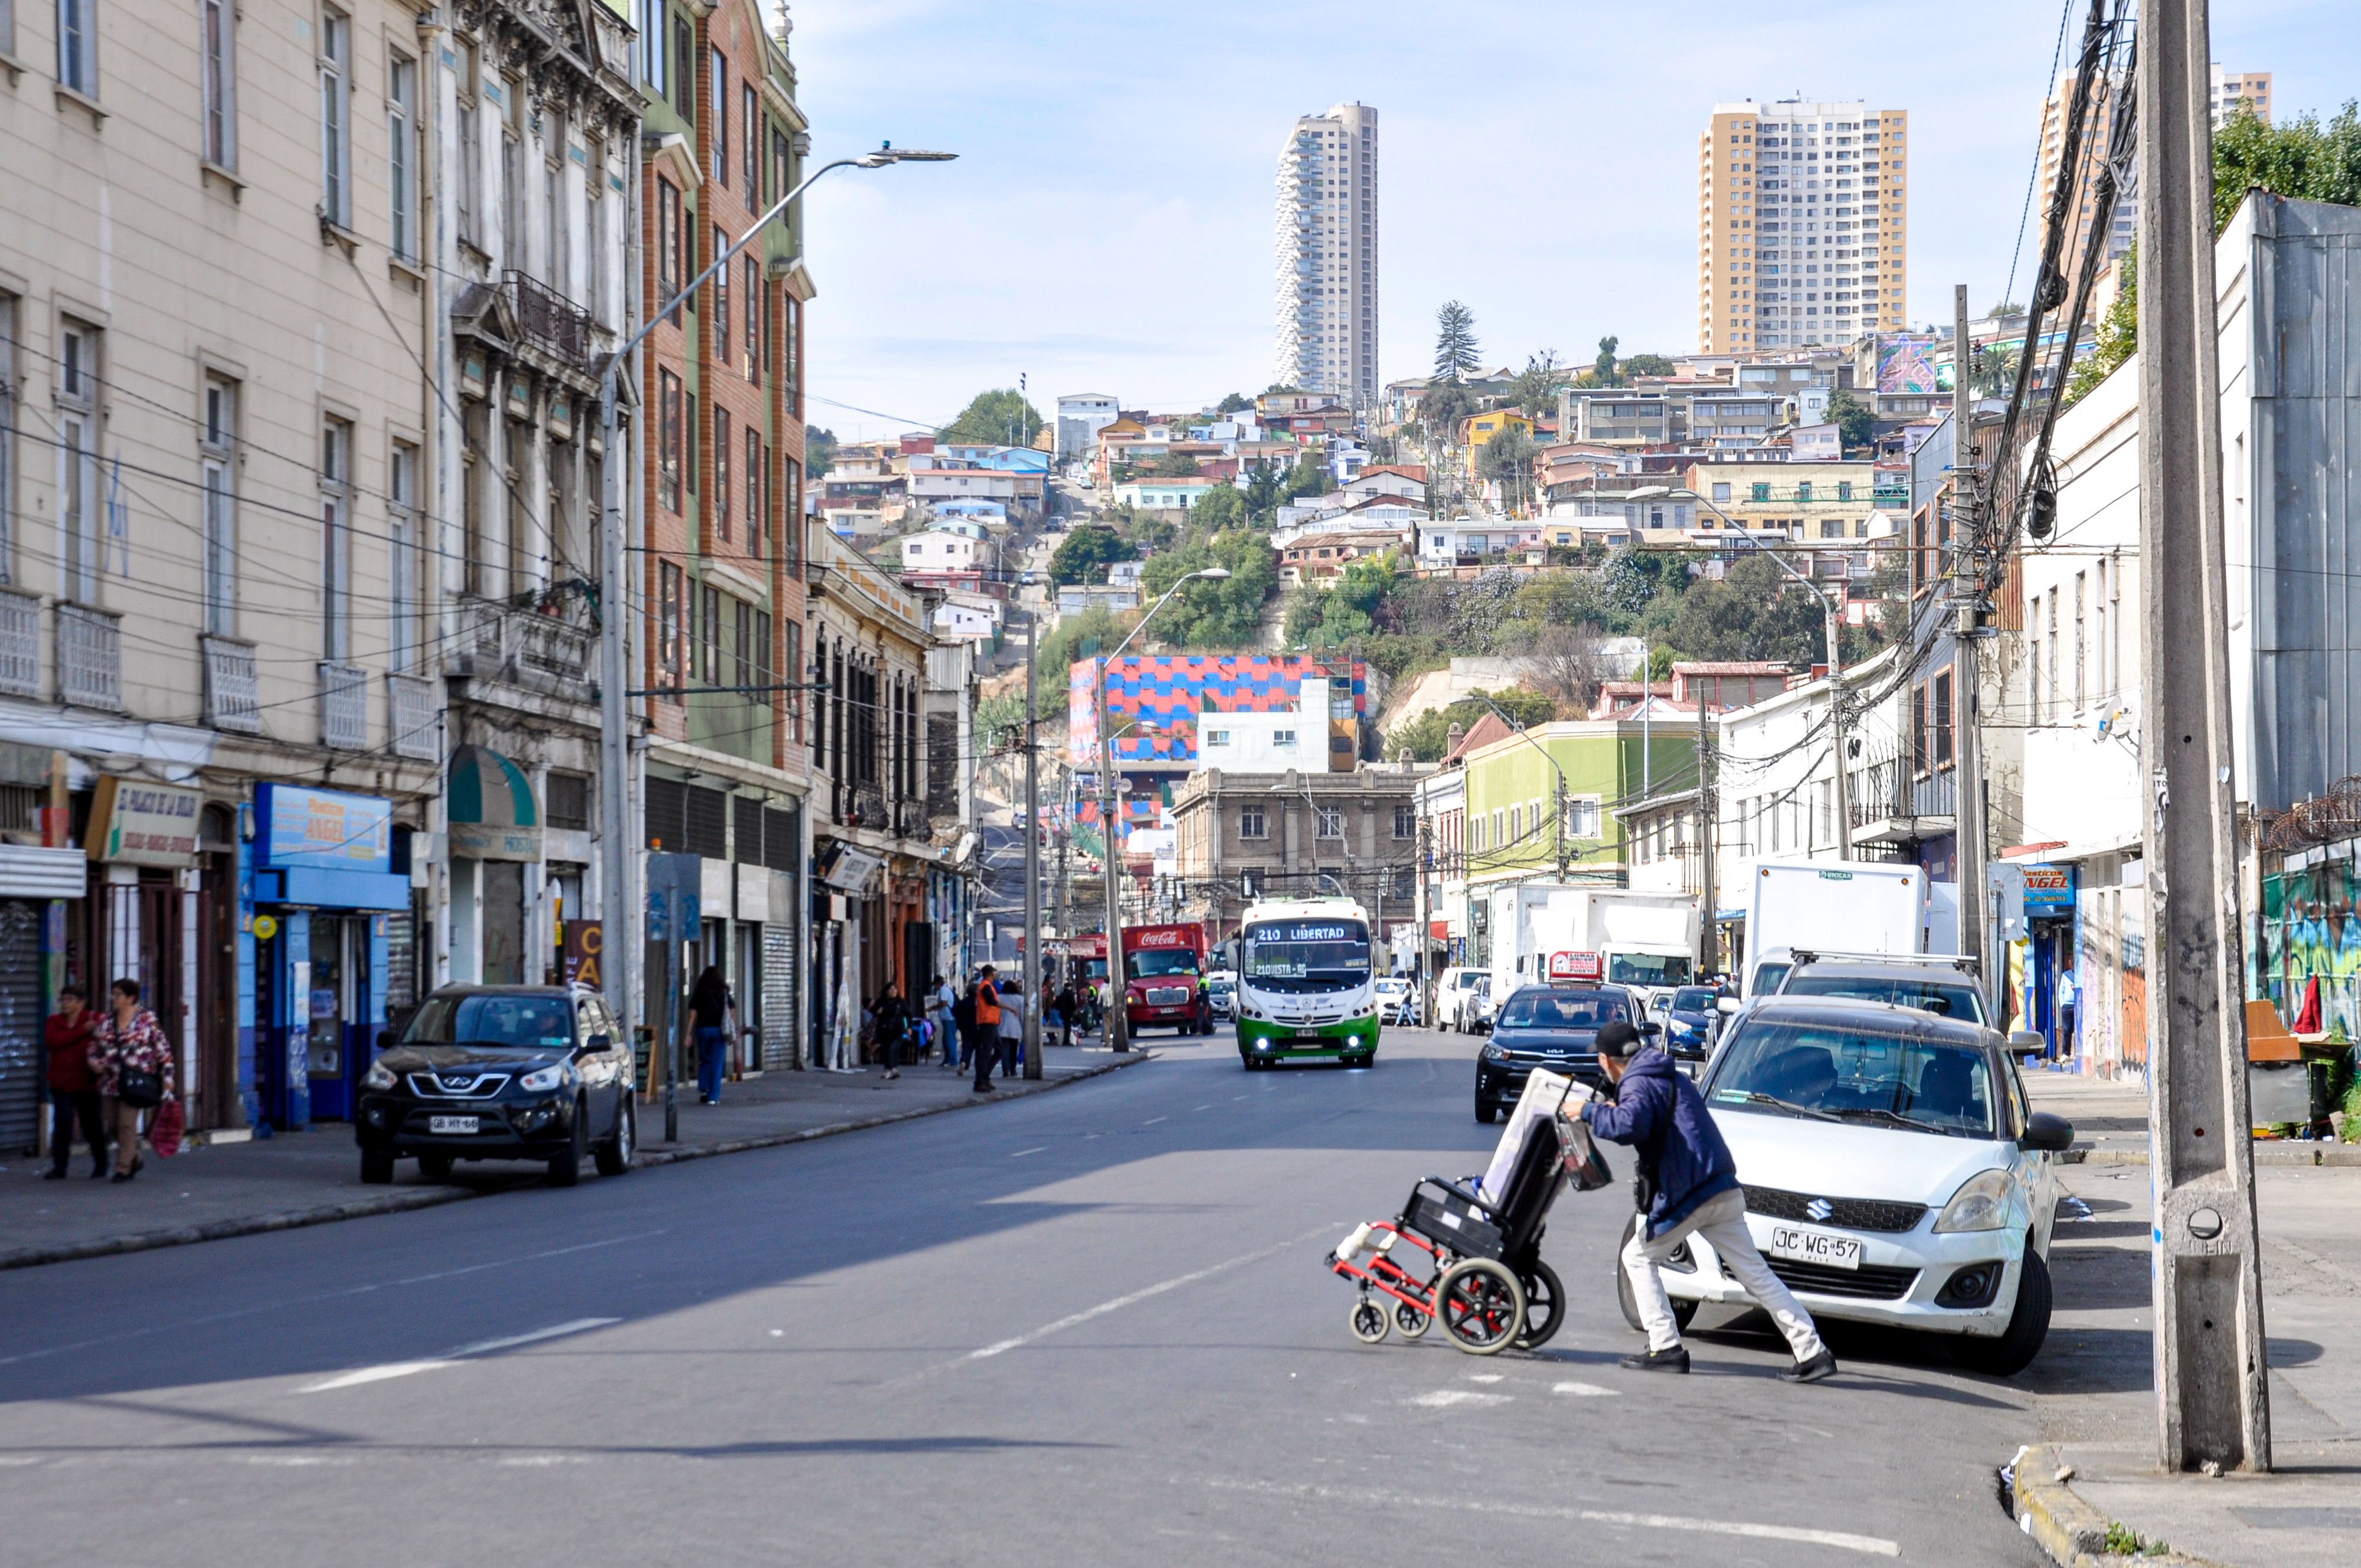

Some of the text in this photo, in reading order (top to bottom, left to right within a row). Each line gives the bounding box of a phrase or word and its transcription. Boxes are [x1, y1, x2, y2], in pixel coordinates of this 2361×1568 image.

[305, 817, 346, 843] ANGEL
[2023, 877, 2068, 888] NGEL
[1258, 928, 1345, 941] 210 LIBERTAD
[1270, 964, 1291, 974] VISTA
